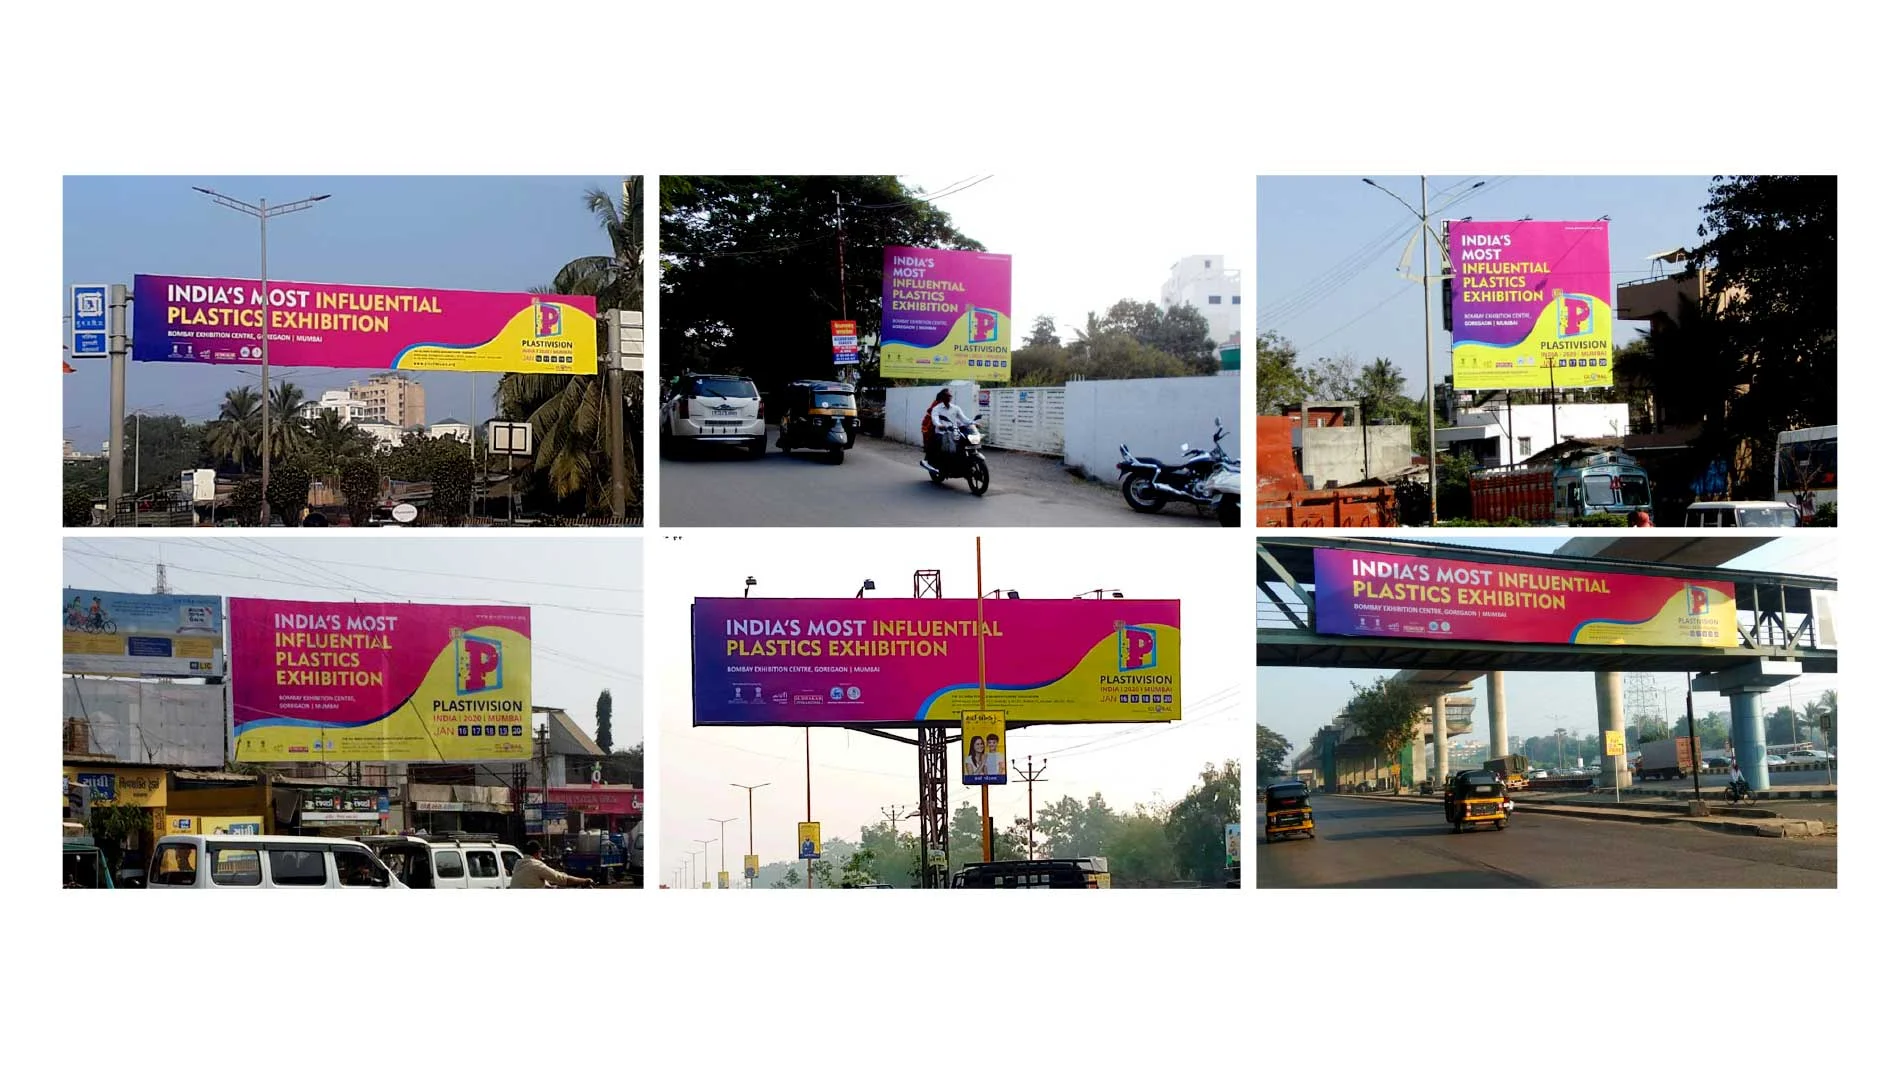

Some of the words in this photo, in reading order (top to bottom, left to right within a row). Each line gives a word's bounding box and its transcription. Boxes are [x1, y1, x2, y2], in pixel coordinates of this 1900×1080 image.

[1462, 234, 1512, 247] INDIA'S
[1462, 248, 1502, 261] MOST
[893, 255, 935, 268] INDIA'S
[1463, 262, 1551, 274] INFLUENTIAL
[893, 267, 926, 278] MOST
[893, 278, 966, 292] INFLUENTIAL
[1463, 275, 1526, 288] PLASTICS
[168, 284, 245, 305] INDIA'S
[251, 287, 310, 309] MOST
[316, 292, 442, 314] INFLUENTIAL
[893, 290, 945, 302] PLASTICS
[1463, 290, 1544, 303] EXHIBITION
[893, 301, 959, 313] EXHIBITION
[168, 307, 264, 328] PLASTICS
[272, 310, 389, 333] EXHIBITION
[167, 330, 195, 338] BOMBAY
[195, 331, 231, 339] EXHIBITION
[296, 335, 323, 343] MUMBAI
[521, 340, 573, 349] PLASTIVISION
[954, 344, 1008, 353] PLASTIVISION
[1540, 340, 1607, 350] PLASTIVISION
[1352, 559, 1430, 581] INDIA'S
[1436, 567, 1493, 586] MOST
[1498, 571, 1611, 594] INFLUENTIAL
[1353, 580, 1452, 604] PLASTICS
[1457, 588, 1566, 609] EXHIBITION
[1354, 603, 1382, 611] BOMBAY
[1383, 605, 1418, 613] EXHIBITION
[275, 613, 341, 630] INDIA'S
[347, 615, 398, 631] MOST
[726, 619, 801, 636] INDIA'S
[807, 620, 867, 637] MOST
[872, 620, 1003, 638] INFLUENTIAL
[275, 632, 393, 649] INFLUENTIAL
[726, 640, 822, 657] PLASTICS
[829, 640, 948, 657] EXHIBITION
[276, 652, 360, 668] PLASTICS
[276, 670, 383, 686] EXHIBITION
[1100, 675, 1173, 684] PLASTIVISION
[433, 700, 523, 712] PLASTIVISION
[433, 714, 457, 722] INDIA
[433, 727, 455, 738] JAN
[512, 727, 521, 735] 20
